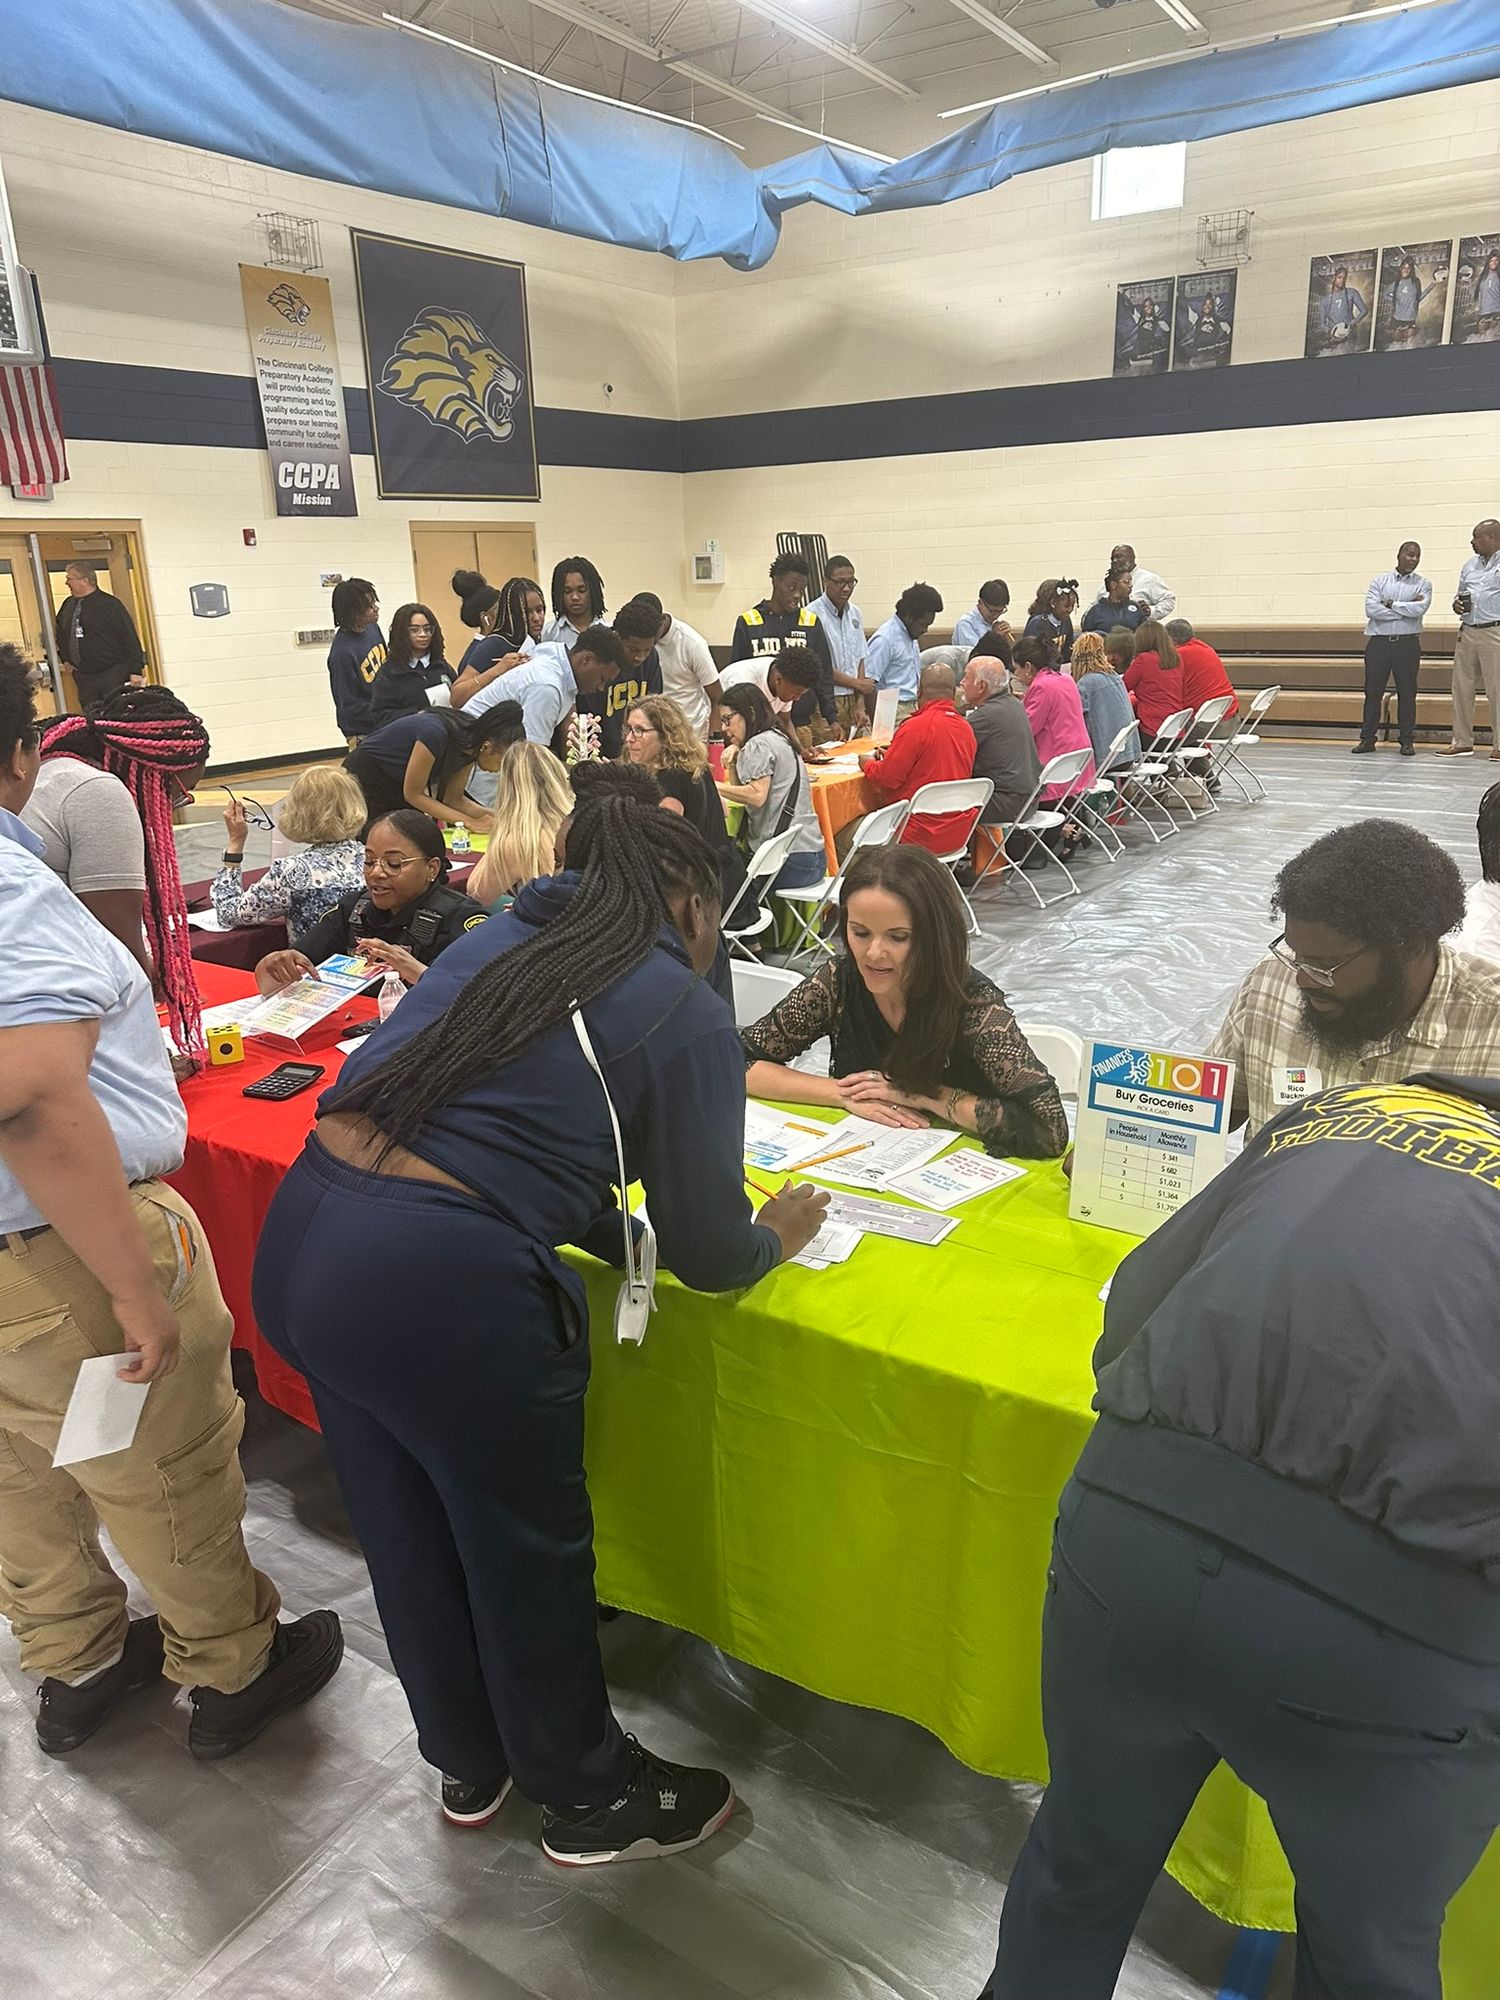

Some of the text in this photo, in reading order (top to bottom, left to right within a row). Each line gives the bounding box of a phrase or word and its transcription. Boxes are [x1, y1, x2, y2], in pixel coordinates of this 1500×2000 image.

[256, 357, 334, 375] The Cincinnati College
[260, 369, 334, 386] Preparatory Academy
[265, 382, 331, 395] will provide holistic
[263, 394, 310, 406] programming
[324, 399, 336, 407] top
[264, 405, 338, 418] quality education that
[266, 417, 298, 426] prepares
[311, 420, 338, 430] learning
[267, 428, 341, 440] community for college
[306, 442, 340, 450] readiness.
[278, 461, 341, 490] CCPA
[292, 493, 332, 506] Mission
[1092, 1048, 1221, 1097] FINANCES 101
[1287, 1084, 1305, 1092] Rico
[1115, 1089, 1195, 1113] Buy Groceries
[1153, 1108, 1170, 1116] CARD
[1118, 1122, 1139, 1133] People
[1115, 1129, 1148, 1142] Household
[1160, 1131, 1186, 1143] Monthly
[1157, 1138, 1188, 1150] Allowance
[1167, 1154, 1179, 1162] 341
[1166, 1167, 1178, 1175] 682
[1159, 1177, 1182, 1189] $1,023
[1158, 1189, 1179, 1200] $1,364
